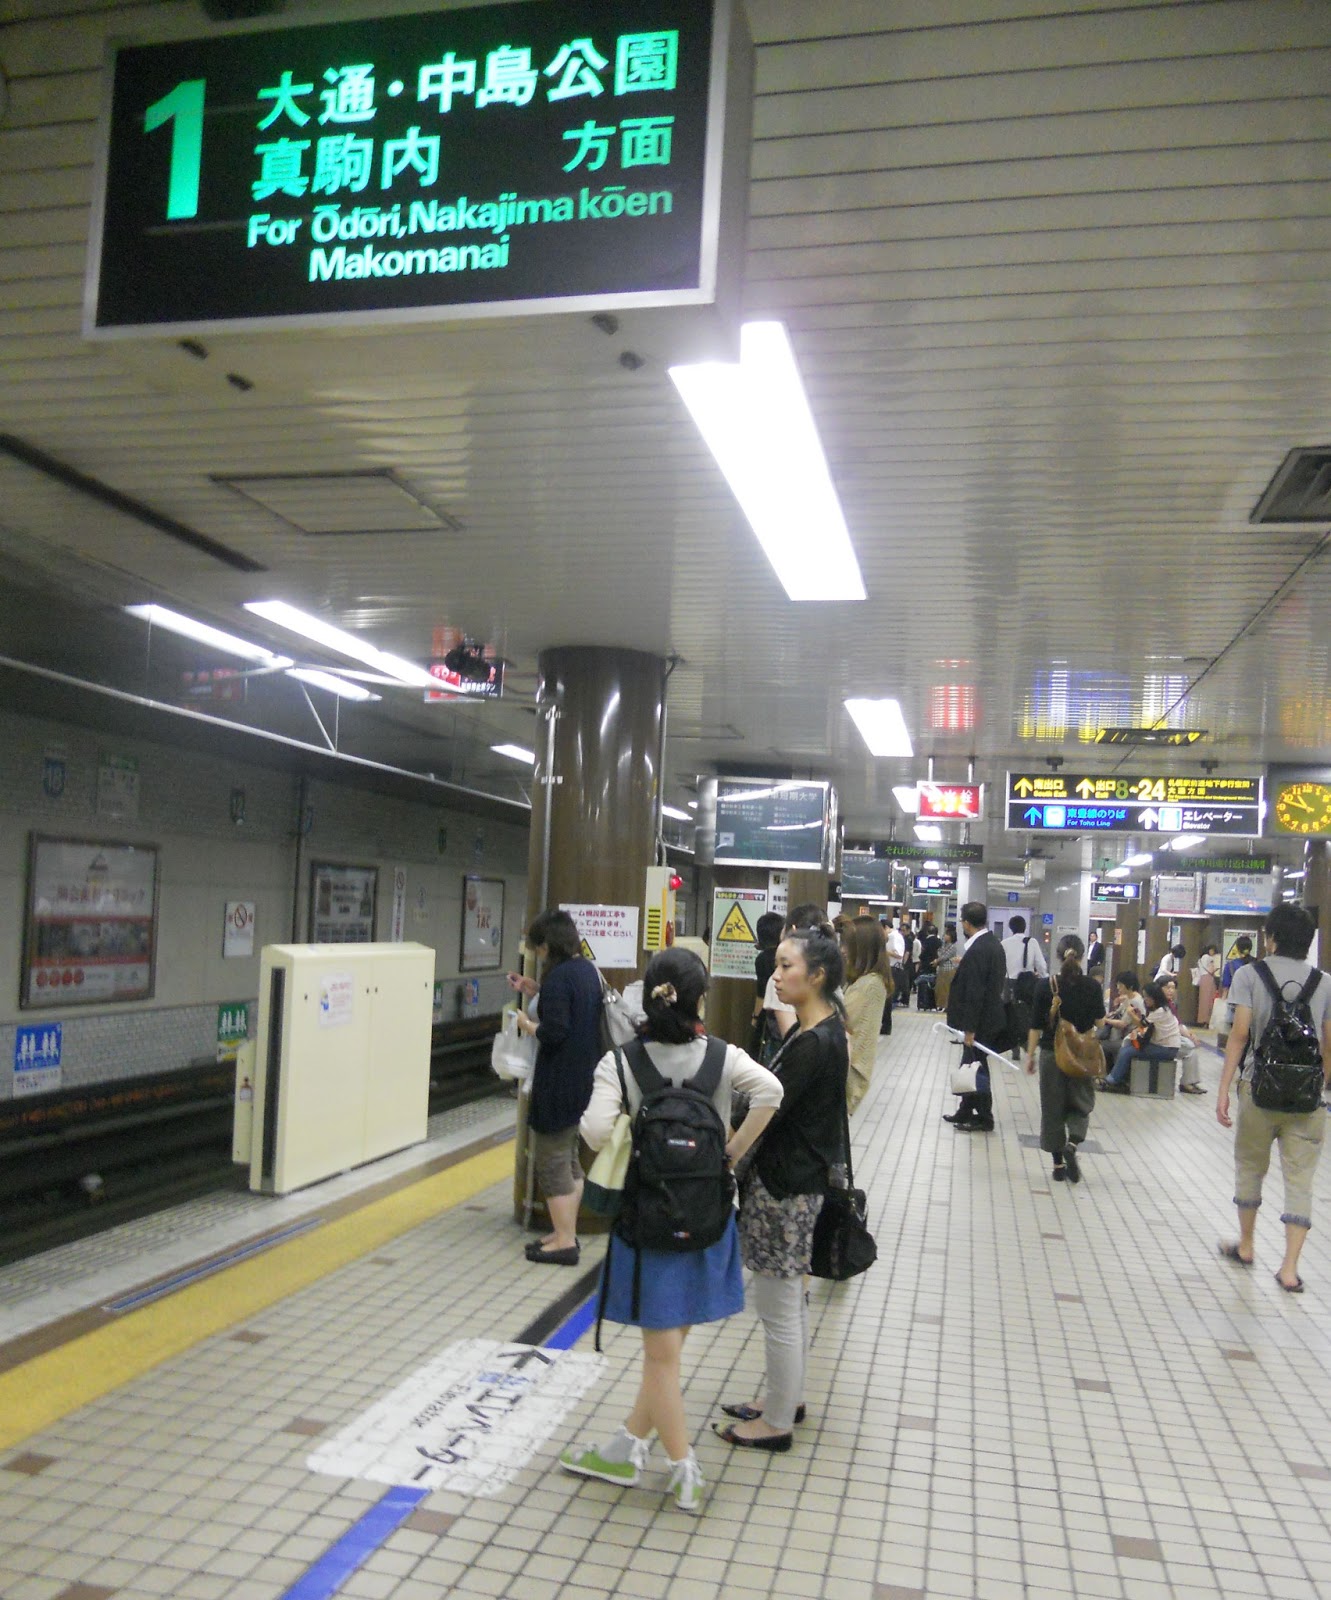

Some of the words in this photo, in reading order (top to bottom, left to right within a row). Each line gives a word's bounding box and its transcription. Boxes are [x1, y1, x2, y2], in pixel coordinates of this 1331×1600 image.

[257, 30, 678, 130] 大通・中島公園
[146, 81, 204, 219] 1
[252, 126, 440, 201] 真駒内
[562, 116, 674, 172] 方面
[248, 214, 302, 247] For
[579, 186, 672, 219] kōen
[309, 234, 510, 282] Makomanai
[1183, 810, 1243, 822] エレベーター
[413, 1388, 523, 1481] エレベーター
